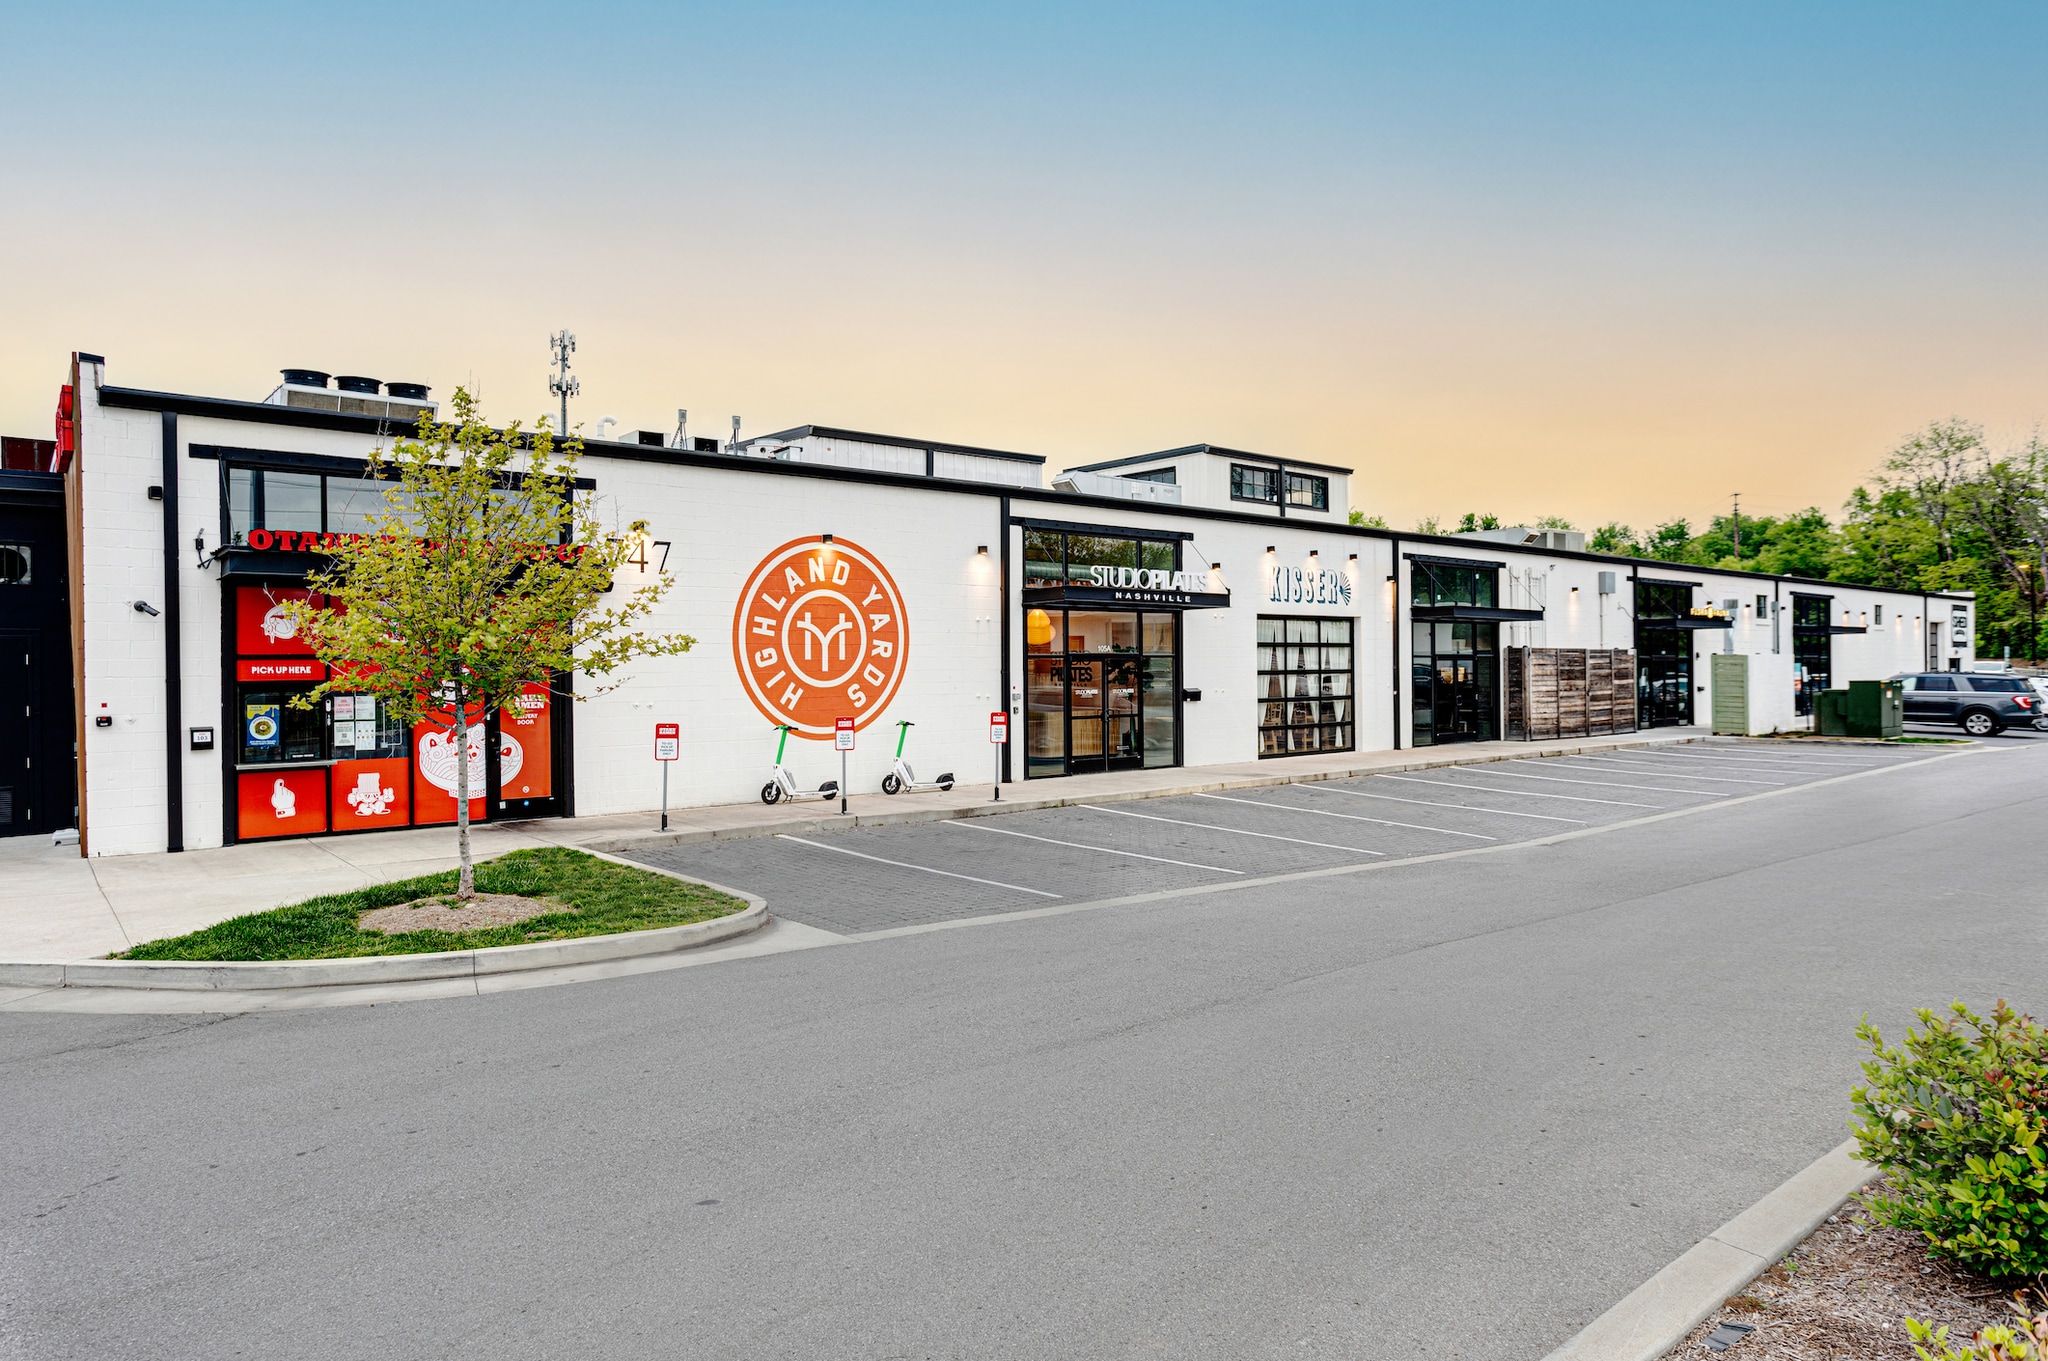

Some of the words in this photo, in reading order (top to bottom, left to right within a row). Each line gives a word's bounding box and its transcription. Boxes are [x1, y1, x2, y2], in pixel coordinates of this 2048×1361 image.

[1269, 566, 1338, 604] KISSER
[1115, 591, 1191, 603] NASHVILLE
[752, 557, 850, 711] HIGHLAND
[847, 584, 893, 708] YARDS
[251, 666, 273, 674] PICK
[275, 666, 288, 674] UP
[288, 666, 311, 674] HERE
[1050, 667, 1093, 682] PILTES
[508, 701, 545, 709] AMEN
